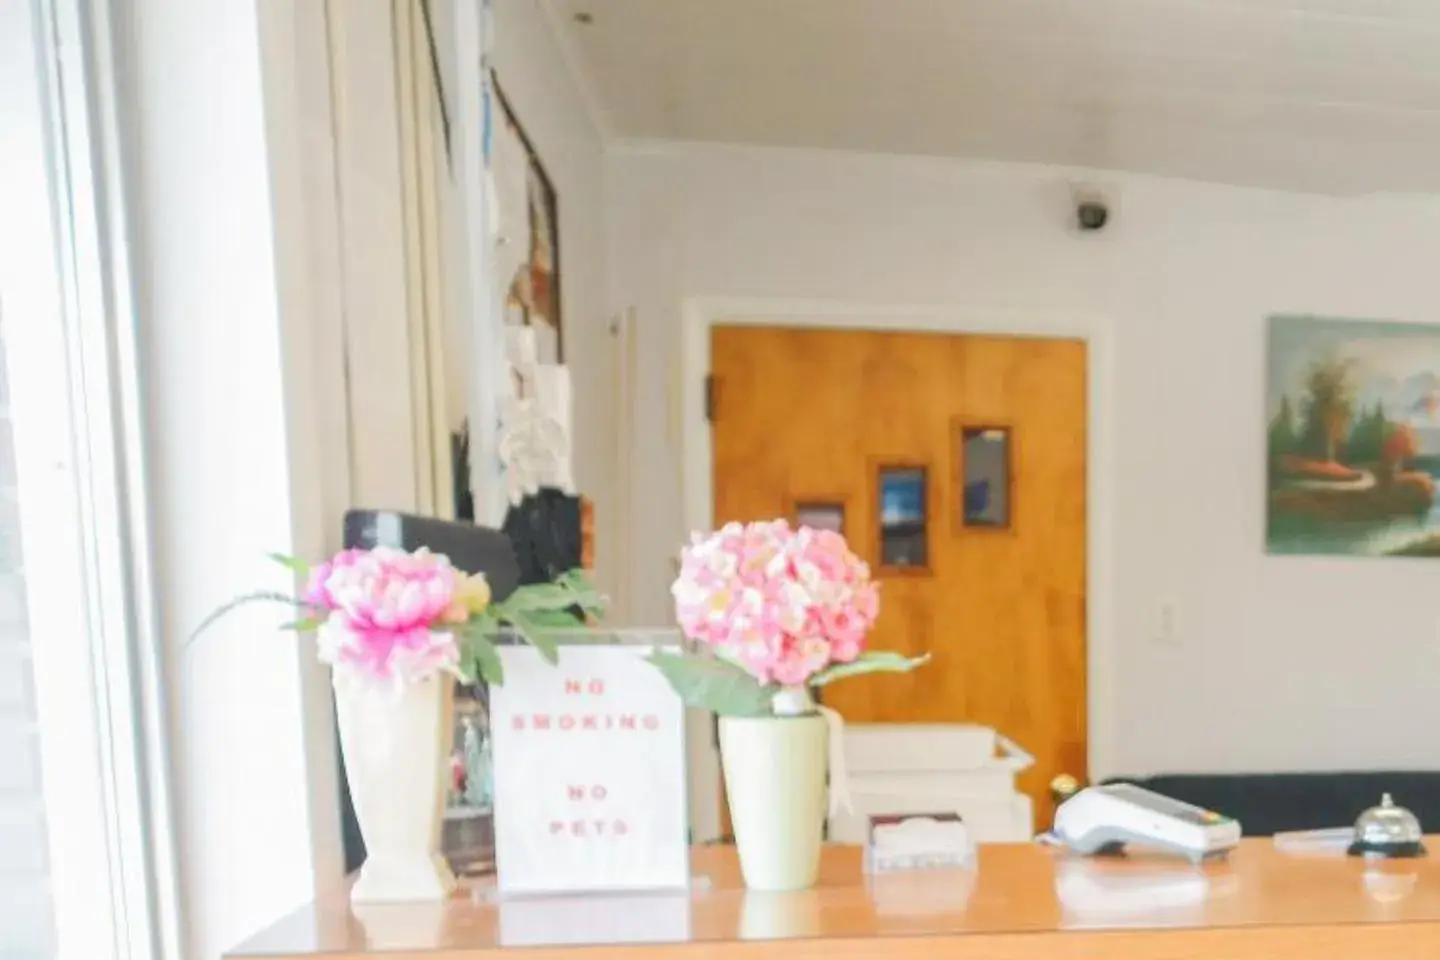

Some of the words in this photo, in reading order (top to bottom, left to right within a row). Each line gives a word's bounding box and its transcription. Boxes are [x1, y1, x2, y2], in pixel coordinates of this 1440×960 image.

[564, 678, 605, 694] NO
[510, 713, 660, 731] SMOKING
[567, 785, 607, 801] NO
[549, 820, 628, 836] PETS
